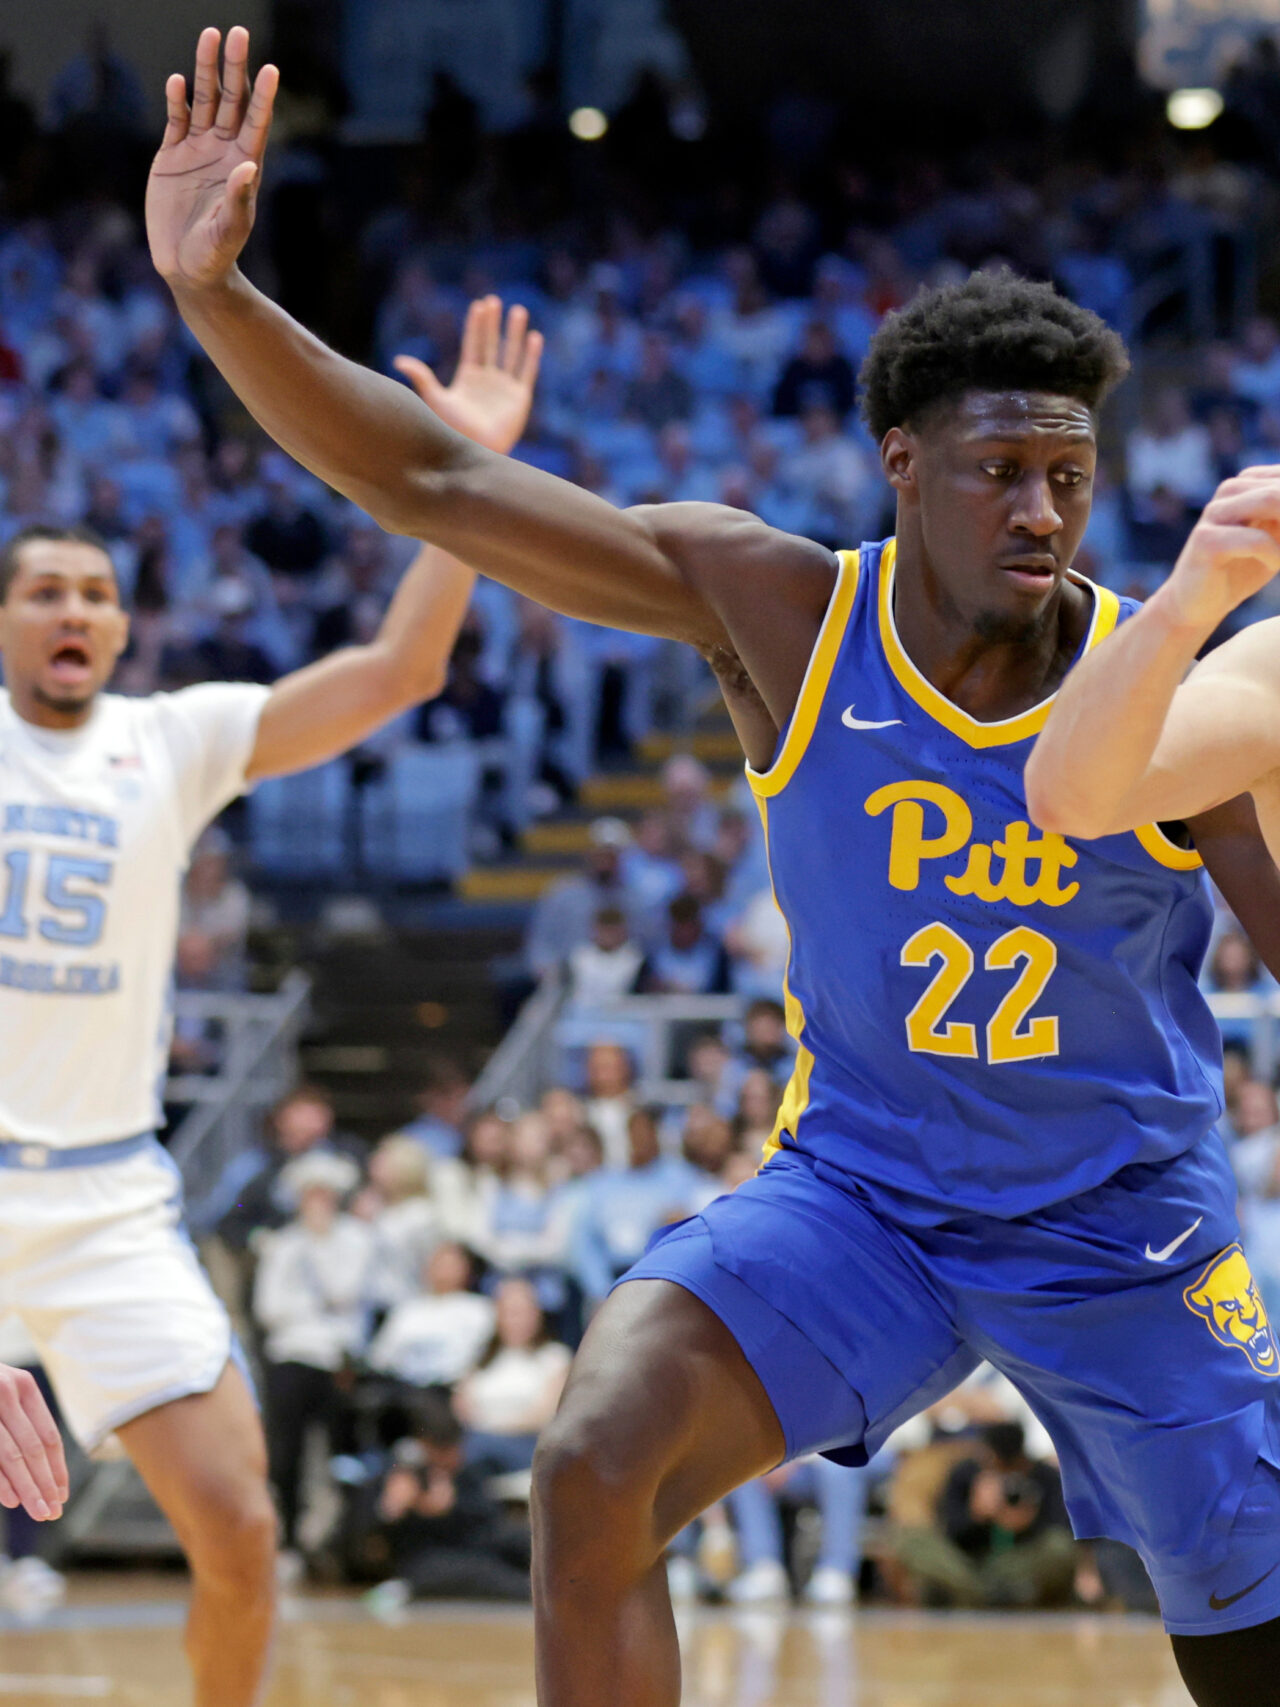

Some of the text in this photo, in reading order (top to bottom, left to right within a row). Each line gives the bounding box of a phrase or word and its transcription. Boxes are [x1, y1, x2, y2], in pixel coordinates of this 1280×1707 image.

[0, 849, 112, 947] 15
[863, 779, 1080, 907] Pitt
[900, 920, 1060, 1065] 22
